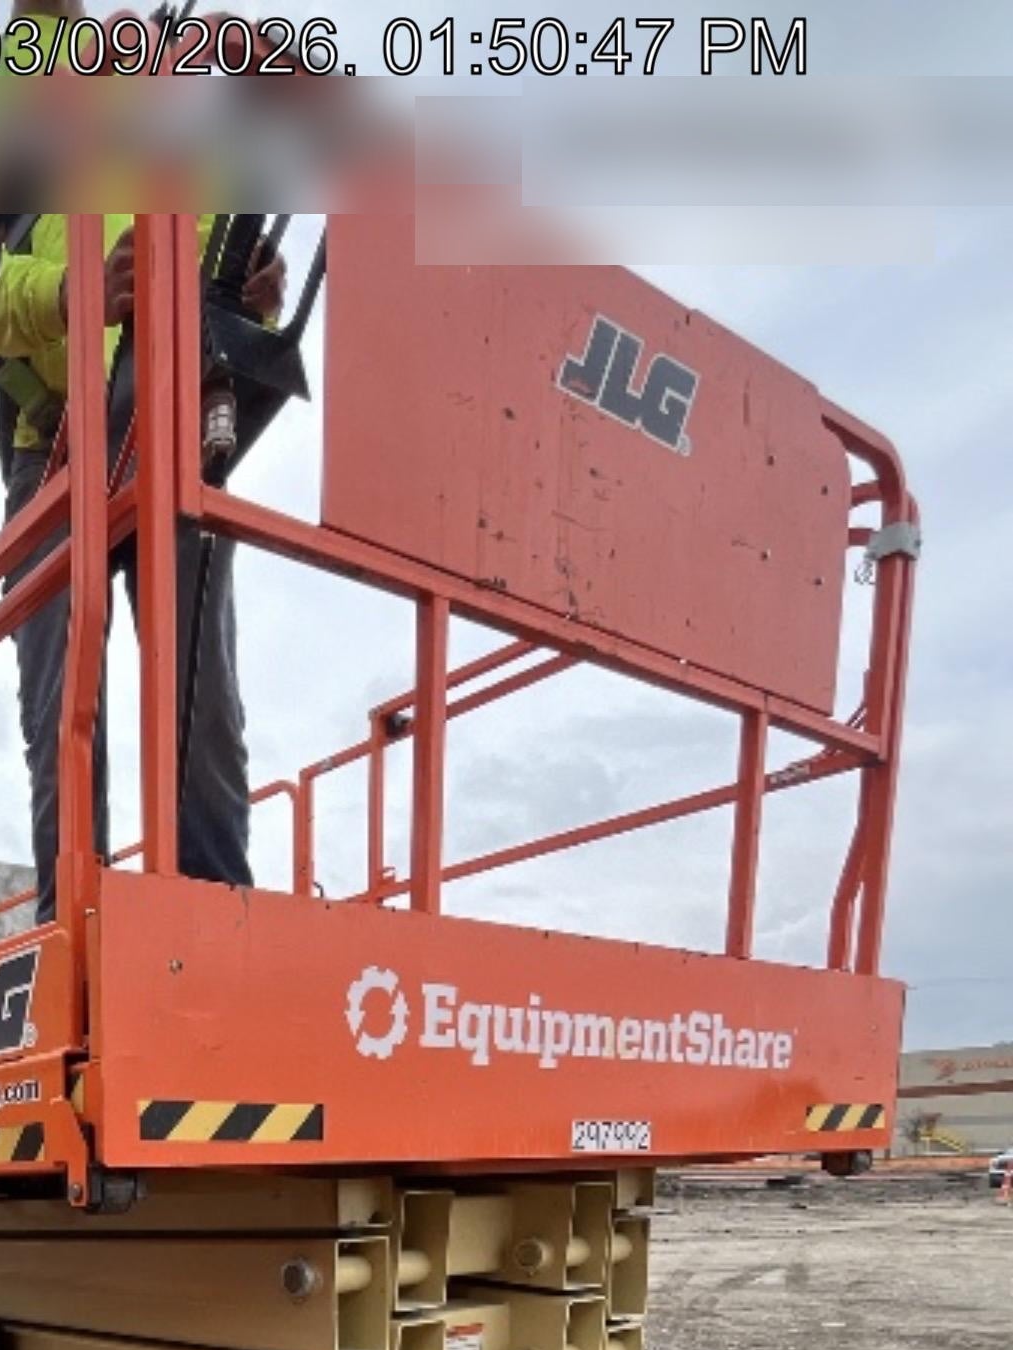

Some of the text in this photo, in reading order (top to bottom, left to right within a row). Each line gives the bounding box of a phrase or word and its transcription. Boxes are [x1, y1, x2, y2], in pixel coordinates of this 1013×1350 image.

[556, 312, 701, 453] JLG
[419, 982, 794, 1070] EquipmentShare
[572, 1121, 650, 1151] 297992
